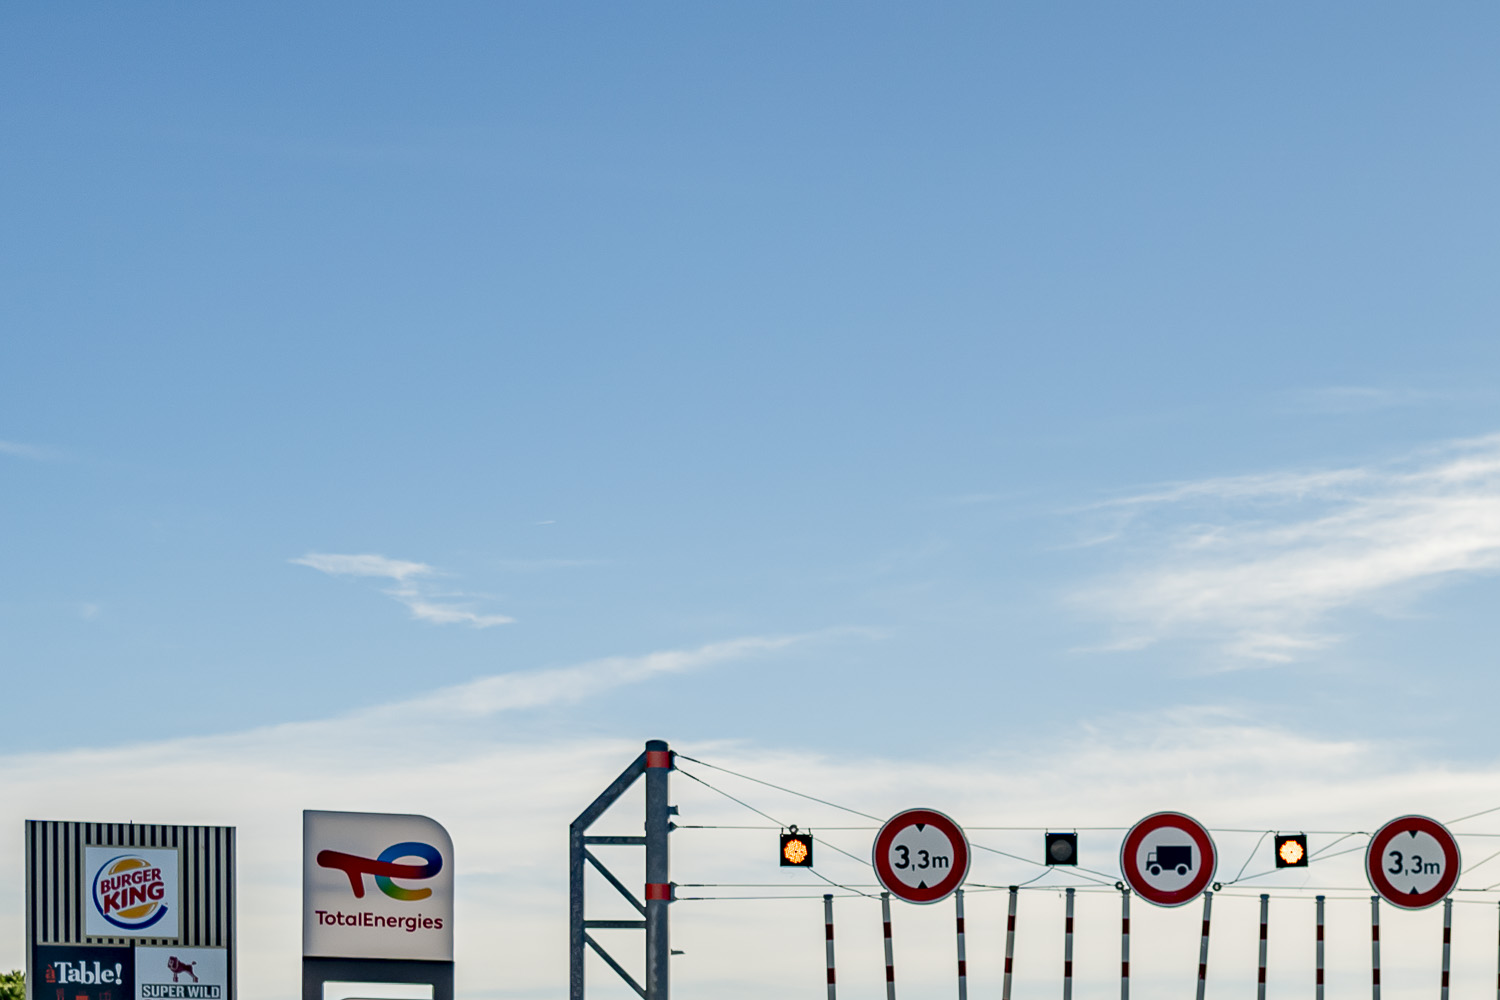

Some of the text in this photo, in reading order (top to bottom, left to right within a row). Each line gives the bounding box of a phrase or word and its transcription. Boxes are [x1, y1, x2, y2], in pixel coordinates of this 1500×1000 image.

[100, 868, 162, 895] BURGER
[103, 881, 165, 915] KING
[315, 910, 444, 933] TotalEnergies
[54, 960, 122, 985] Table!
[143, 985, 220, 998] SUPER WILD
